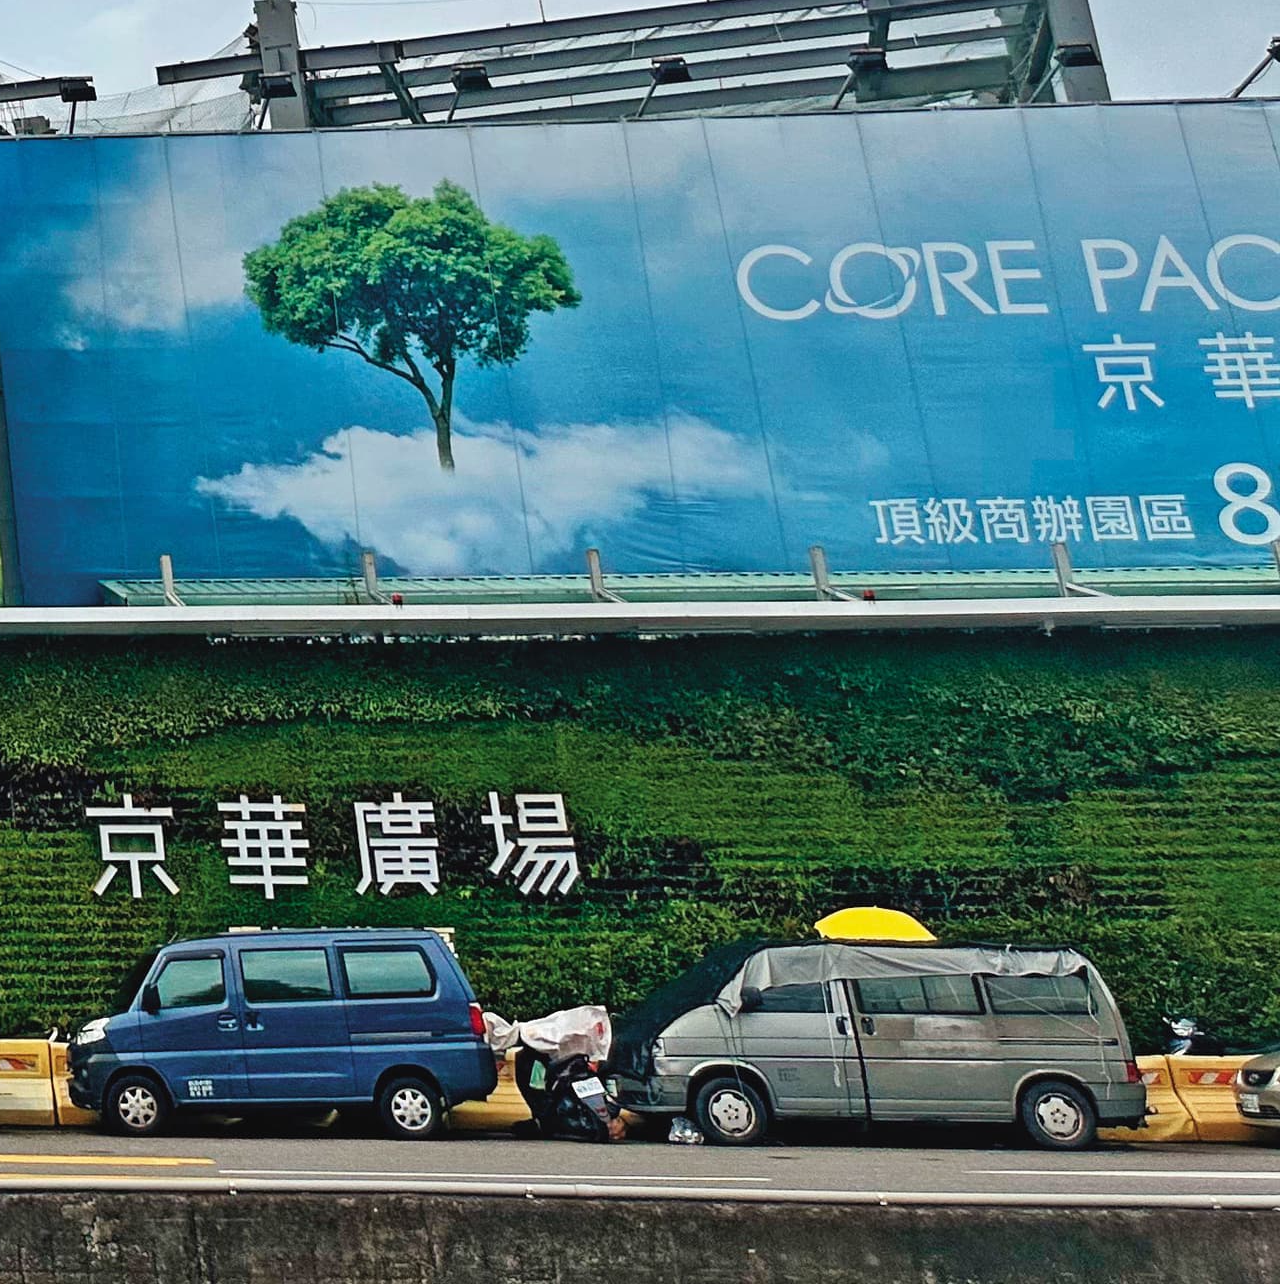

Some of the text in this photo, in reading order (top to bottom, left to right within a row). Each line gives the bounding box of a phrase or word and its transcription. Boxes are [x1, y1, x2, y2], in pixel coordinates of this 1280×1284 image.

[736, 240, 1049, 320] CORE
[1082, 332, 1280, 410] 京華
[869, 494, 1196, 544] 頂級商辦園區
[85, 791, 579, 900] 京華廣場
